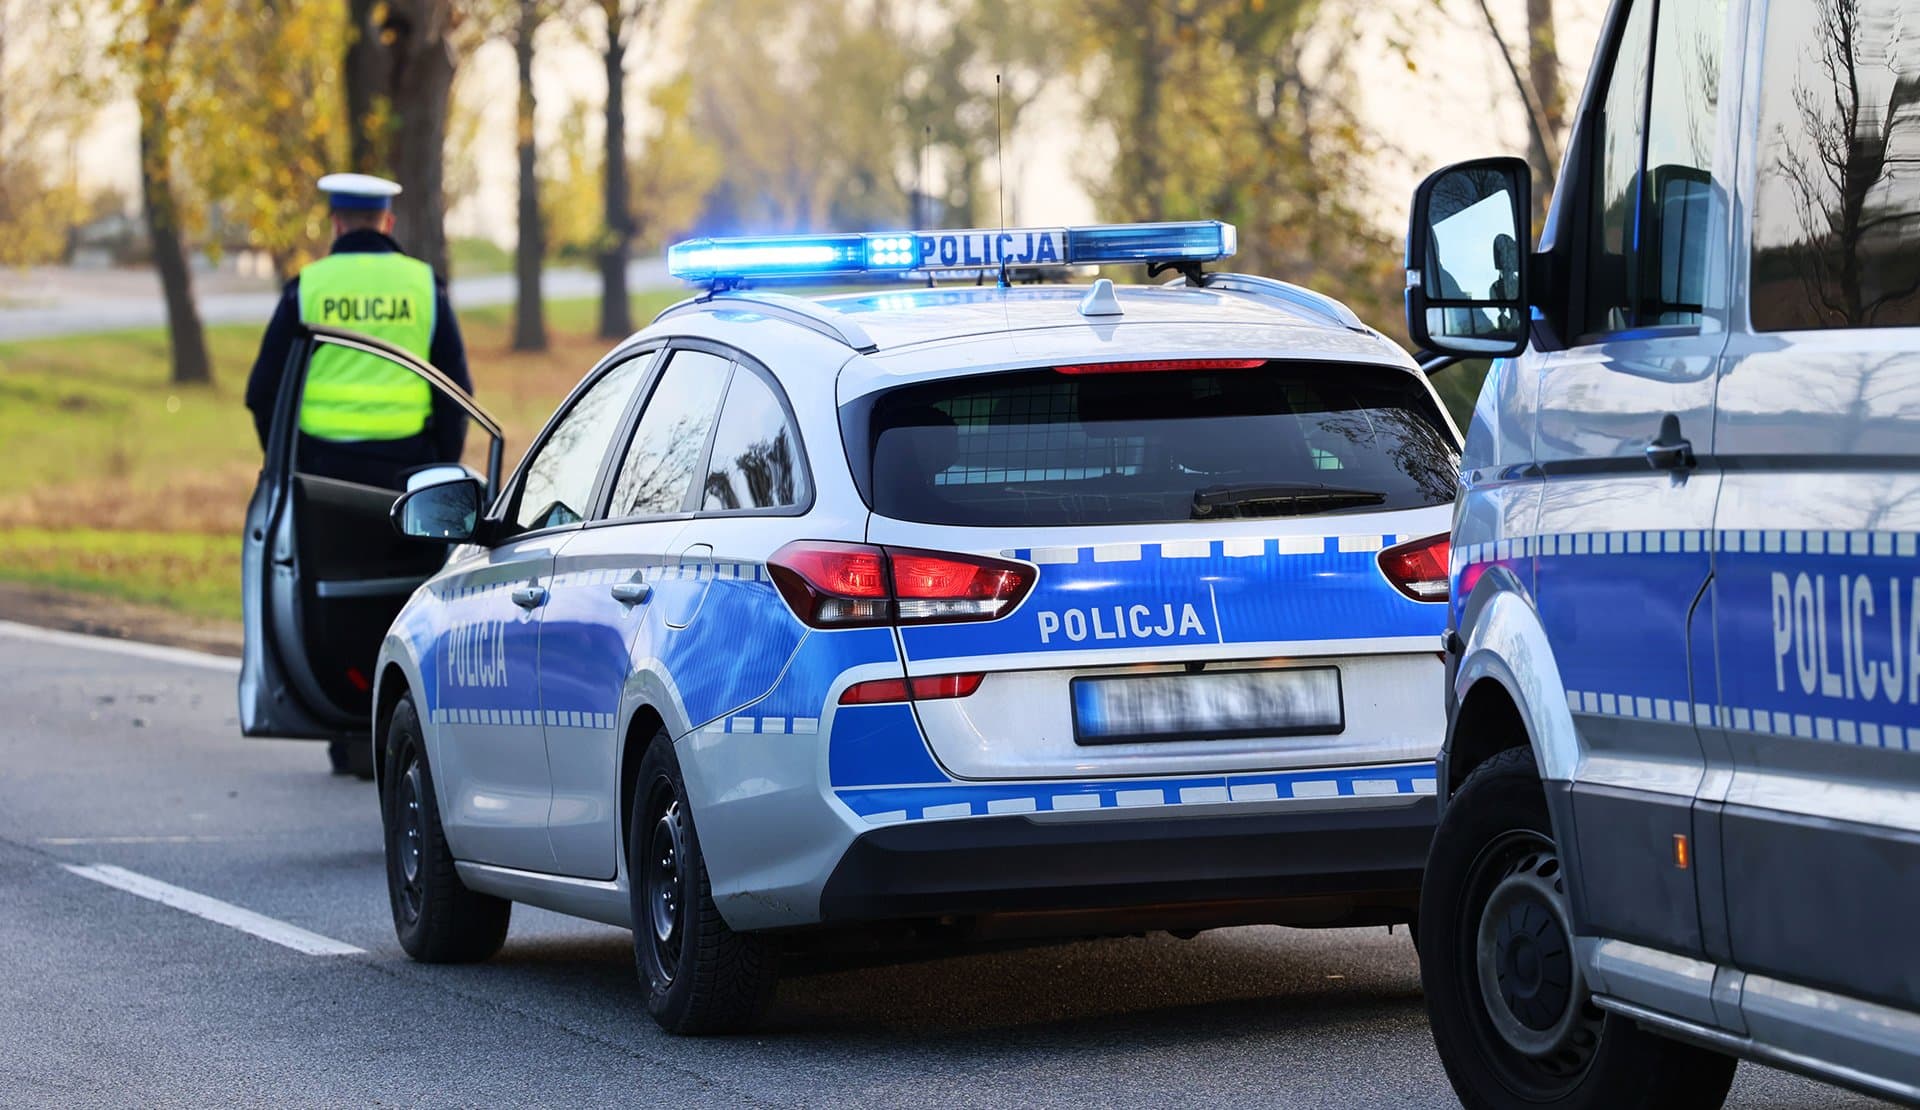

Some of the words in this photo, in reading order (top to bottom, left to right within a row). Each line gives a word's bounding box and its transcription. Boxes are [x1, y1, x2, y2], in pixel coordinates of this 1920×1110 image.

[917, 232, 1058, 267] POLICJA
[323, 298, 411, 321] POLICJA
[1037, 603, 1206, 644] POLICJA
[448, 620, 508, 688] POLICJA
